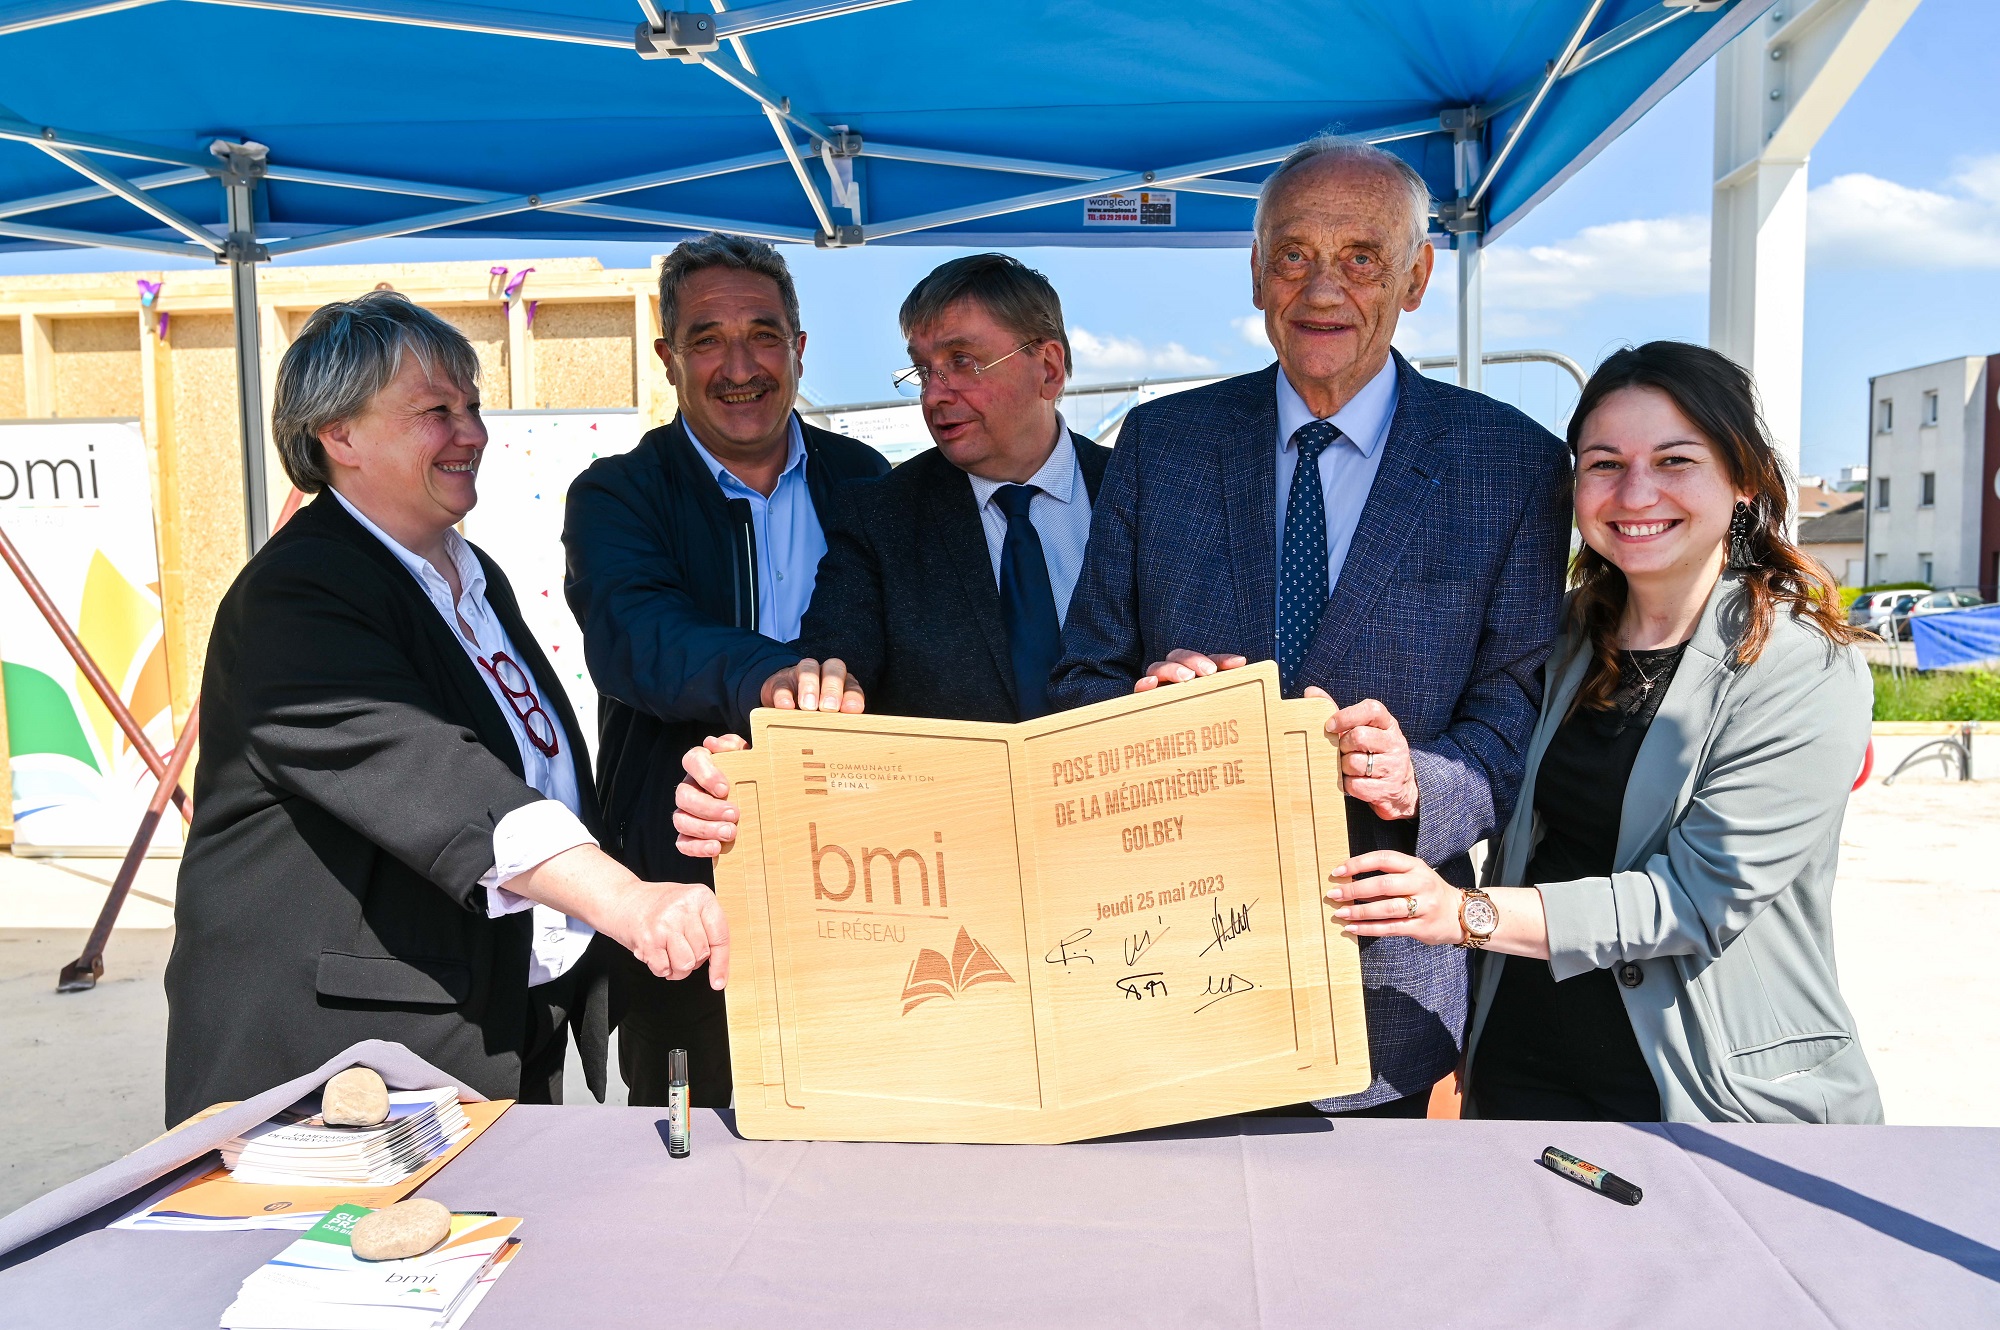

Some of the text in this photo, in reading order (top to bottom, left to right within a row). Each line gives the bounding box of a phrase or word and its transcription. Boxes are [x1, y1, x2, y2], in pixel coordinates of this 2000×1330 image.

[1089, 198, 1136, 208] wongleon
[1052, 719, 1240, 787] POSE DU PREMIER BOIS
[829, 762, 903, 772] COMMUNAUTÉ
[830, 772, 935, 782] D'AGGLOMÉRATION
[831, 780, 870, 789] ÉPINAL
[1054, 759, 1246, 828] DE LA MÉDIATHÈQUE DE
[1121, 815, 1184, 853] GOLBEY
[809, 822, 948, 907] bmi
[1096, 874, 1225, 921] Jeudi 25 mai 2023
[818, 918, 906, 943] LE RÉSEAU
[322, 1223, 341, 1231] DES
[385, 1272, 439, 1284] bmi
